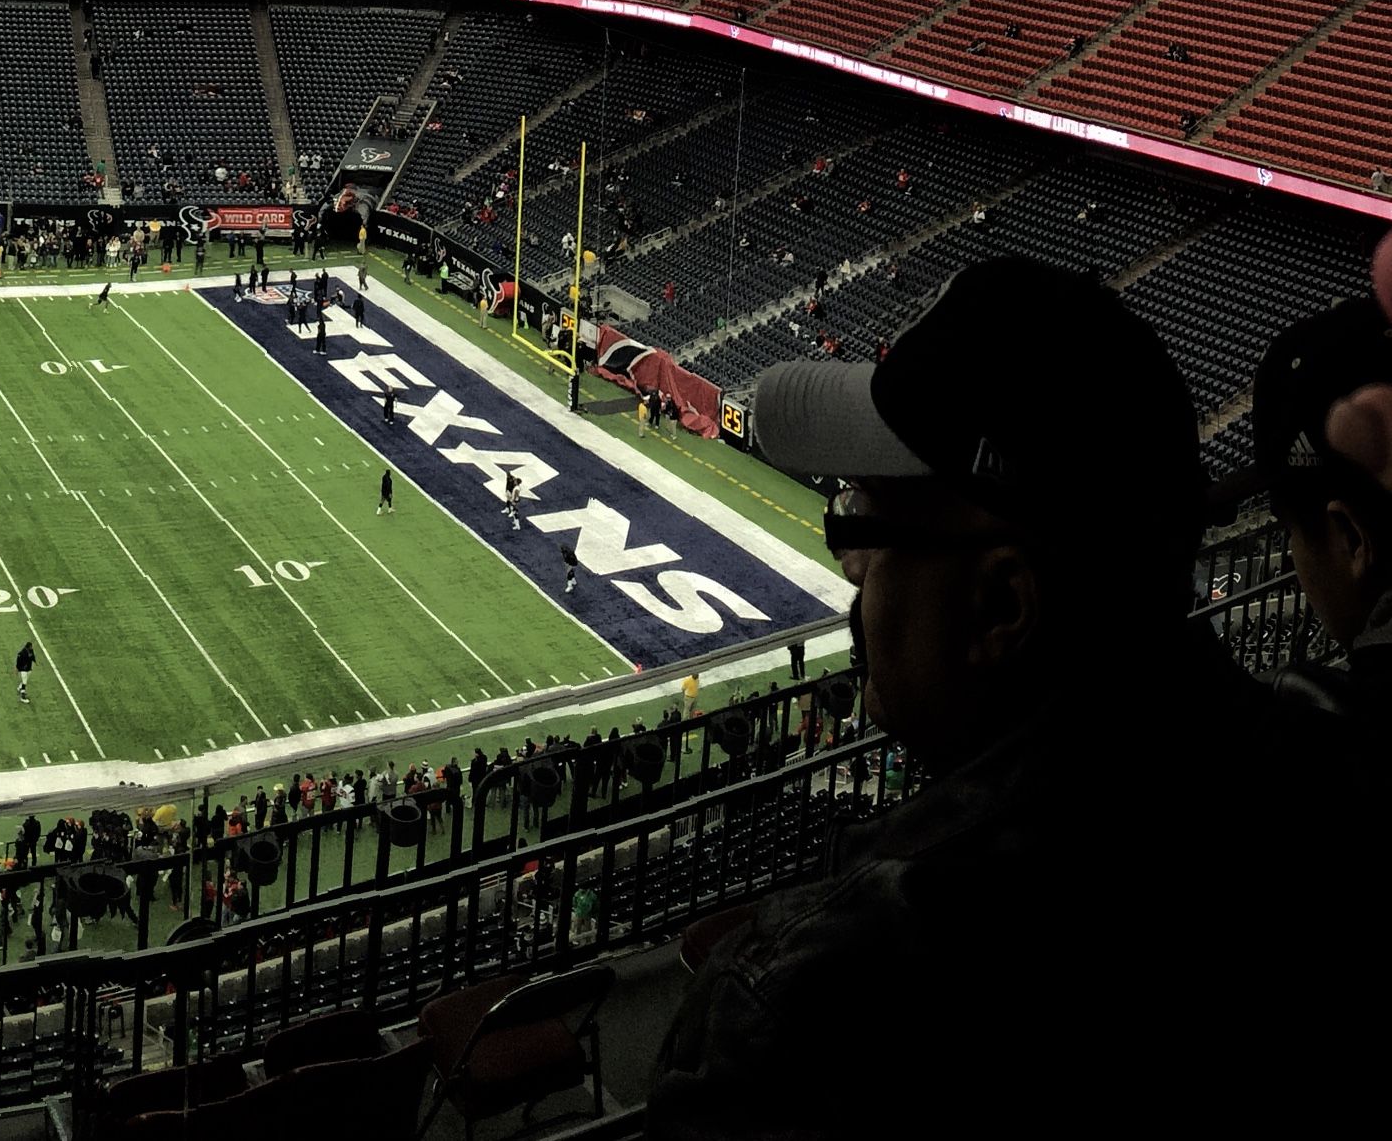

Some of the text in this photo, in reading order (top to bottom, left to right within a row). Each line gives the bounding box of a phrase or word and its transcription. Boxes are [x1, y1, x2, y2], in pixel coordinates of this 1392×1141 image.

[225, 213, 285, 224] WILD CARD
[378, 225, 418, 245] TEXANS
[40, 357, 115, 375] 10
[724, 405, 742, 434] 25
[287, 304, 772, 635] TEXANS
[234, 558, 315, 589] 10
